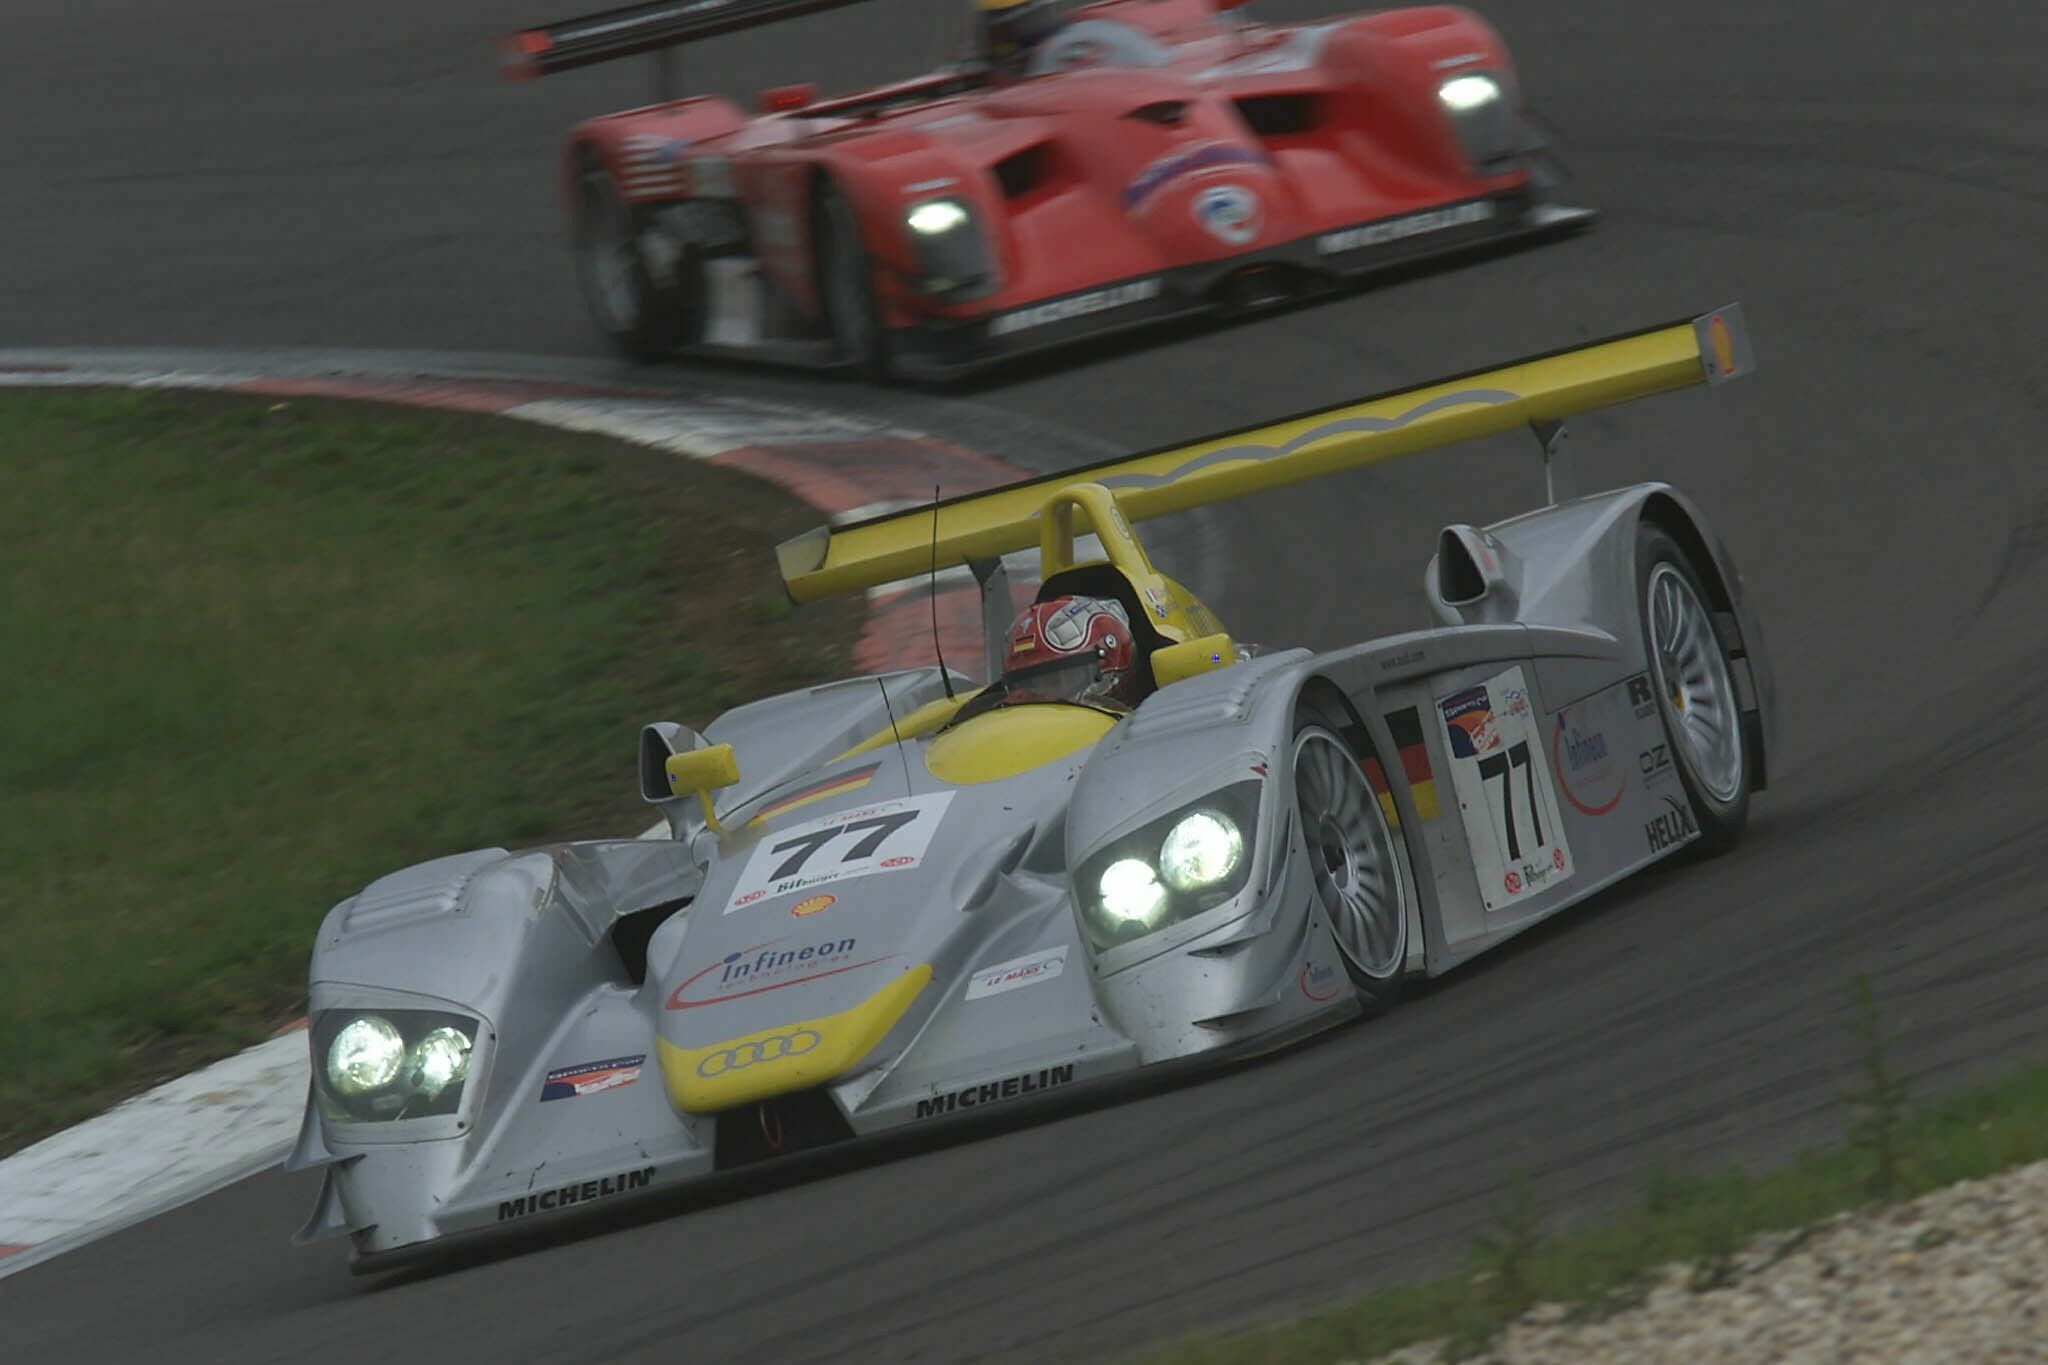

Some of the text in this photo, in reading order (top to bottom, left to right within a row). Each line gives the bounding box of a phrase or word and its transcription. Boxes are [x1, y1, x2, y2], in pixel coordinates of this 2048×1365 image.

[1478, 740, 1545, 861] 77
[1645, 797, 1695, 853] HELIX
[768, 809, 920, 883] 77
[722, 938, 856, 982] Infineon
[916, 1064, 1074, 1119] MICHELIN
[498, 1166, 656, 1220] MICHELIN
